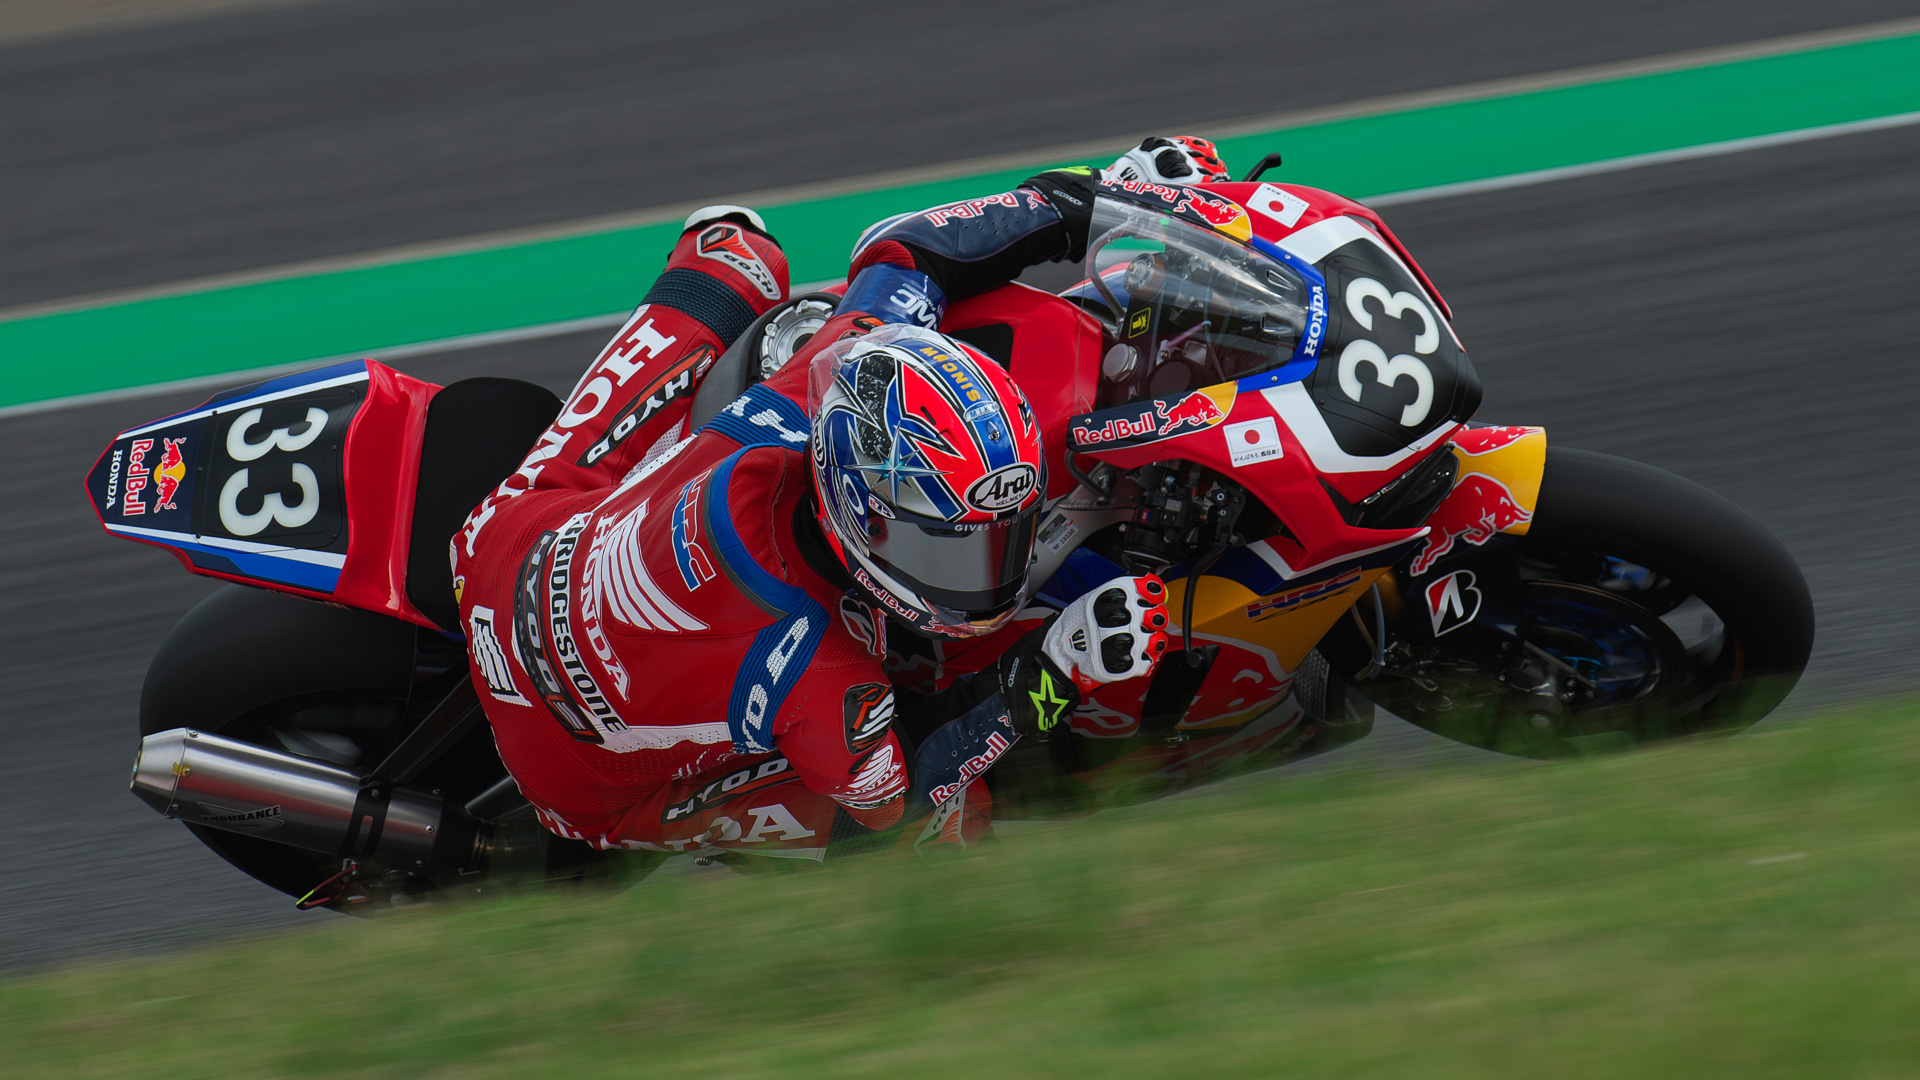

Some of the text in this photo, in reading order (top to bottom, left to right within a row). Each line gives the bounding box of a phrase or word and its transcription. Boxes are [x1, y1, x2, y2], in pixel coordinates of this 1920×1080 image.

[723, 253, 774, 294] HYOD
[1304, 286, 1327, 357] HONDA
[1338, 277, 1440, 428] 33
[587, 369, 690, 464] HYOD
[106, 450, 123, 509] HONDA
[219, 407, 329, 538] 33
[974, 467, 1032, 504] Arai
[671, 469, 717, 592] HRC
[954, 523, 991, 533] GIVES
[997, 515, 1018, 529] YOU
[526, 535, 560, 694] HYOD
[580, 511, 630, 703] HONDA
[1246, 566, 1363, 619] HRC
[202, 806, 281, 822] ENDURANCE
[666, 758, 789, 820] HYOD
